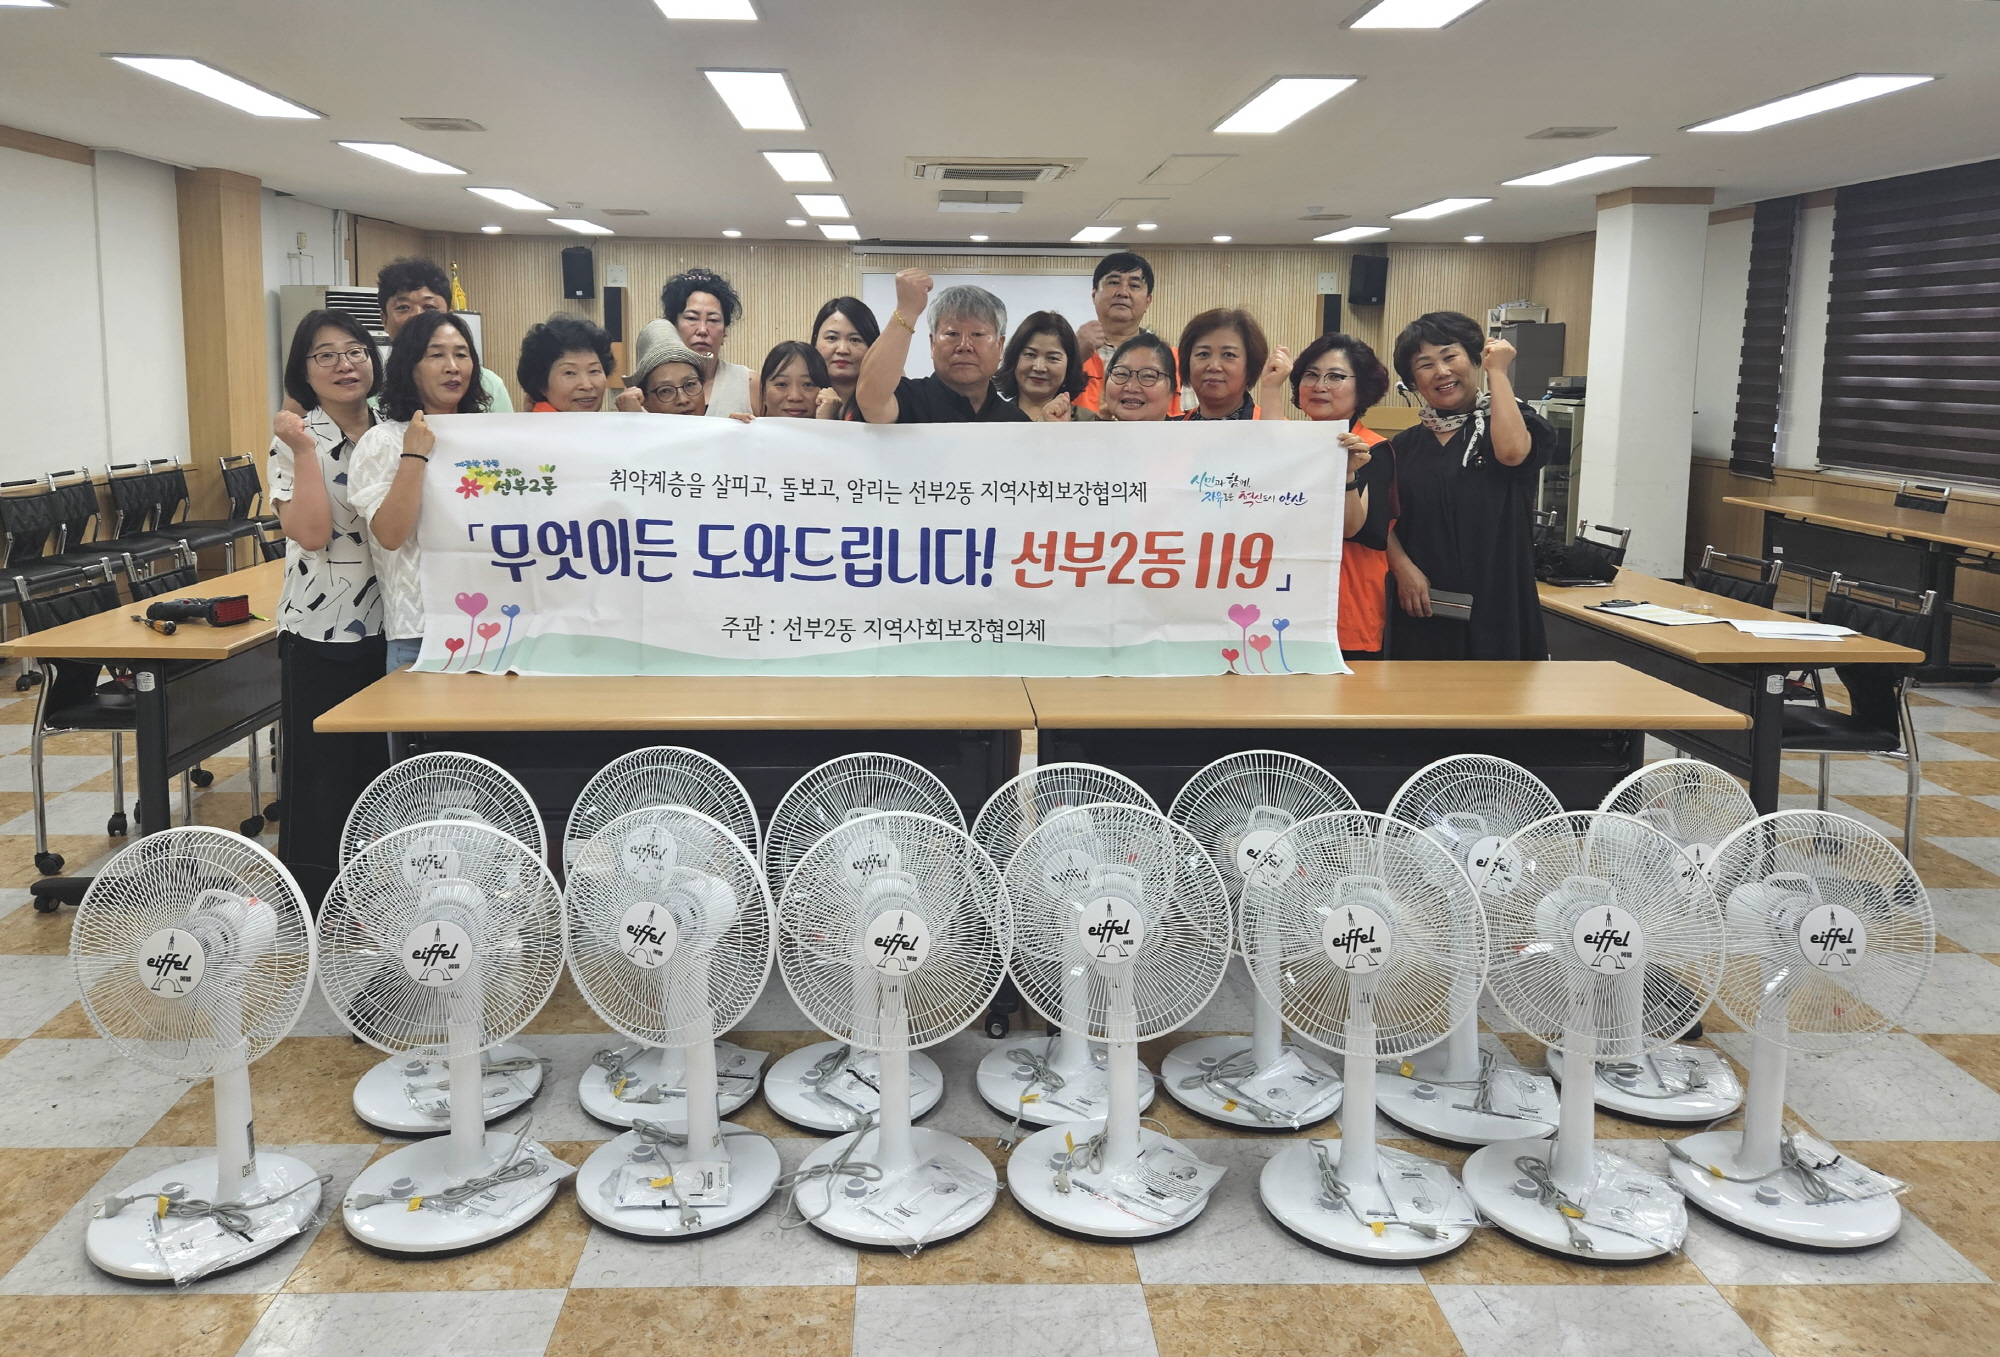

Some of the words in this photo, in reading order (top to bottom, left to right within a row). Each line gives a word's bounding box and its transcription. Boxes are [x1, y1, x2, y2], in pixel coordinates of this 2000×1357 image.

[494, 476, 558, 496] 선부2동
[609, 468, 705, 499] 취약계층을
[711, 473, 772, 500] 살피고,
[779, 477, 840, 502] 돌보고,
[847, 478, 903, 505] 알리는
[908, 480, 975, 506] 선부2동
[980, 480, 1147, 507] 지역사회보장협의체
[1279, 492, 1308, 505] 안산
[692, 523, 997, 588] 도와드립니다!
[721, 615, 763, 642] 주관
[782, 615, 857, 643] 선부2동
[863, 617, 1046, 644] 지역사회보장협의체
[626, 925, 666, 946] eiffel
[1088, 919, 1130, 943] eiffel
[1332, 926, 1375, 954] eiffel
[1583, 929, 1630, 953] eiffel
[1810, 928, 1854, 951] eiffel
[412, 943, 459, 967] eiffel
[874, 933, 919, 956] eiffel
[147, 953, 192, 977] eiffel
